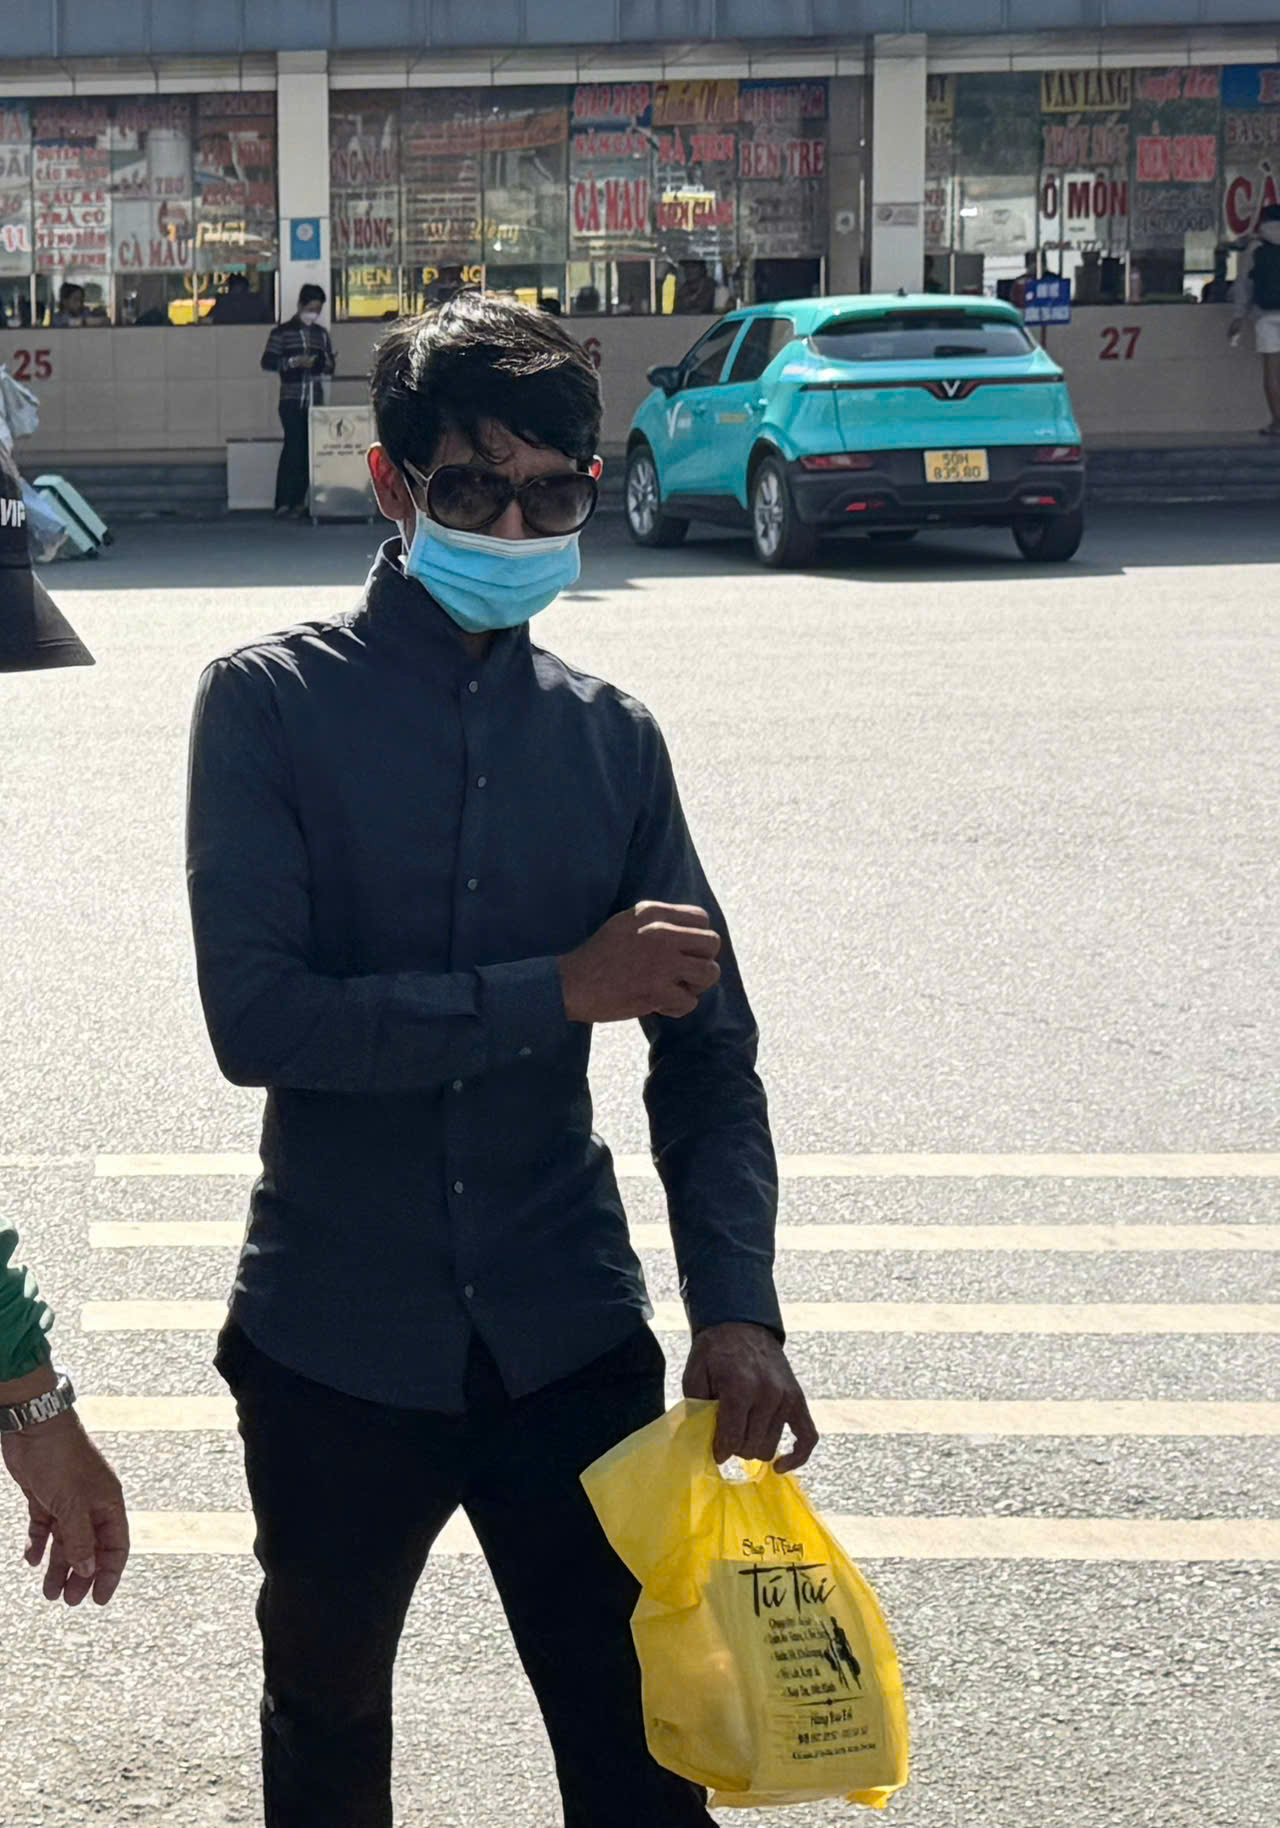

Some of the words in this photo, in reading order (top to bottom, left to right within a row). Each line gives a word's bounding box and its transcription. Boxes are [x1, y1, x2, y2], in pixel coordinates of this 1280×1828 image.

[605, 177, 649, 232] MAU
[1067, 173, 1128, 219] MÔN
[1099, 326, 1142, 360] 27
[13, 348, 53, 381] 25
